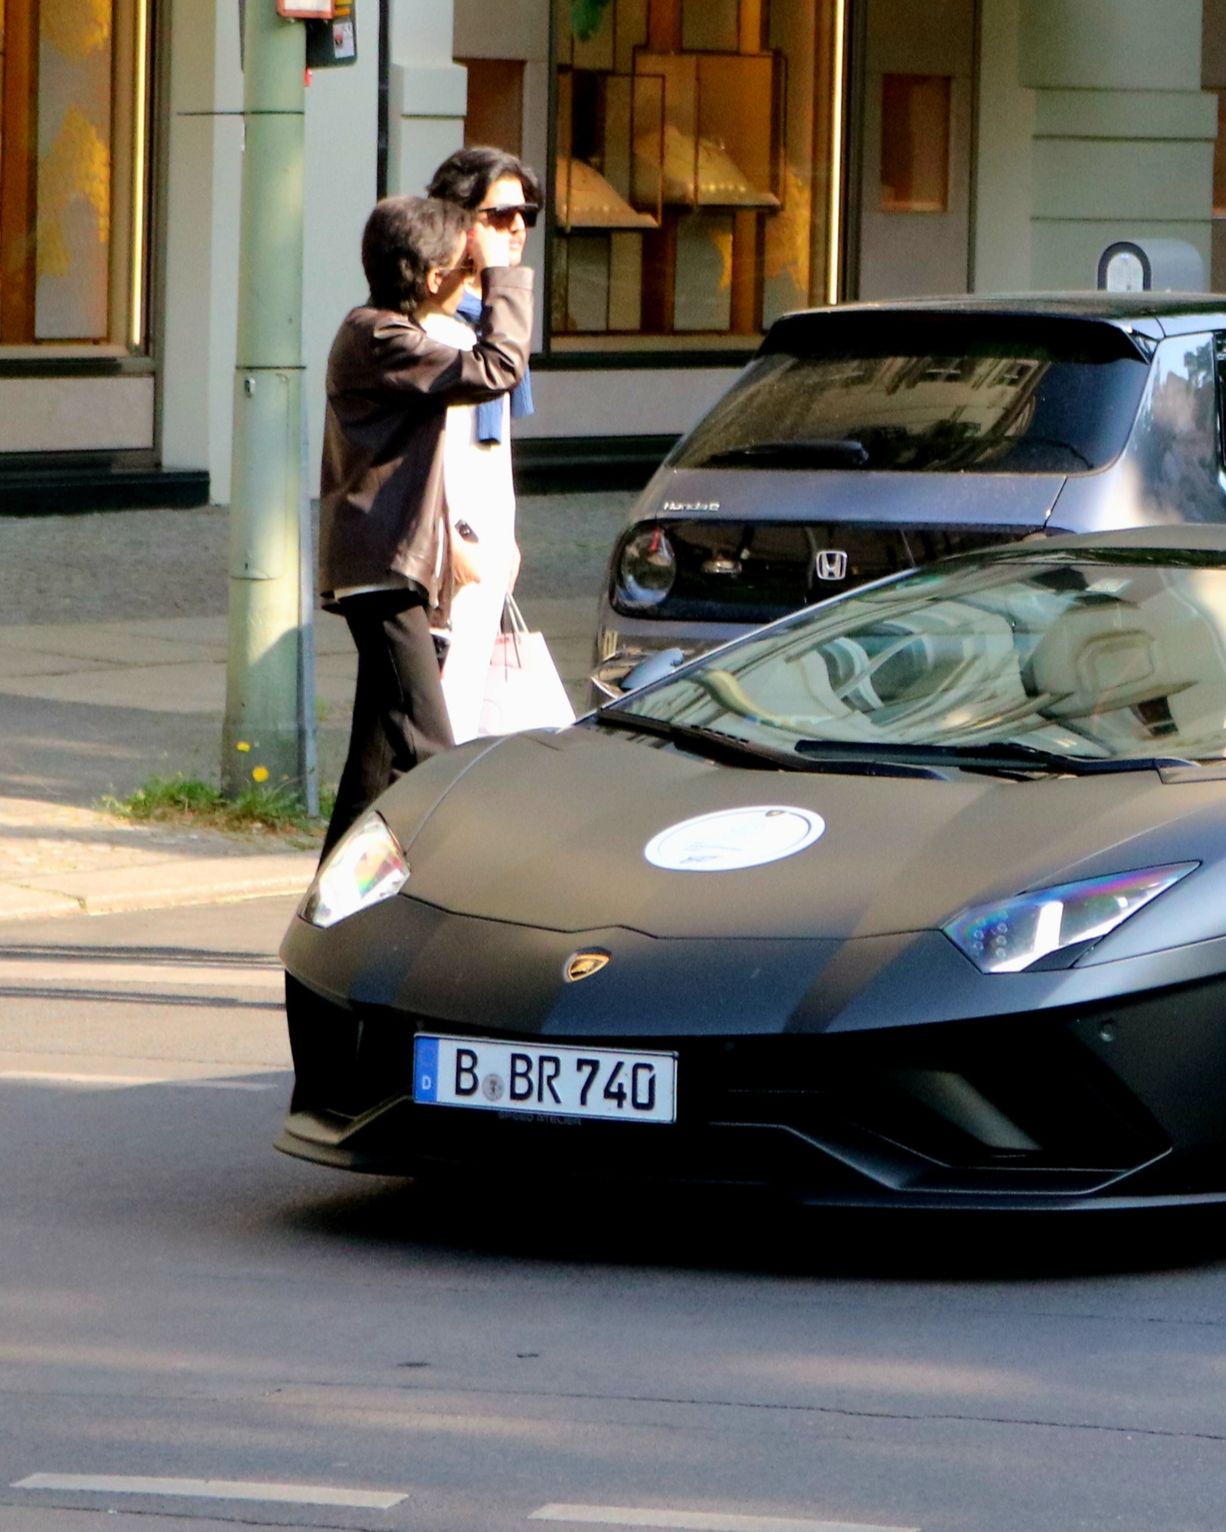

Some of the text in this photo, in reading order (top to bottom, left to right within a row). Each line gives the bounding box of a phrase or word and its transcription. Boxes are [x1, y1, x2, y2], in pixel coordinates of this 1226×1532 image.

[421, 1077, 432, 1090] D
[455, 1048, 656, 1111] B BR 740
